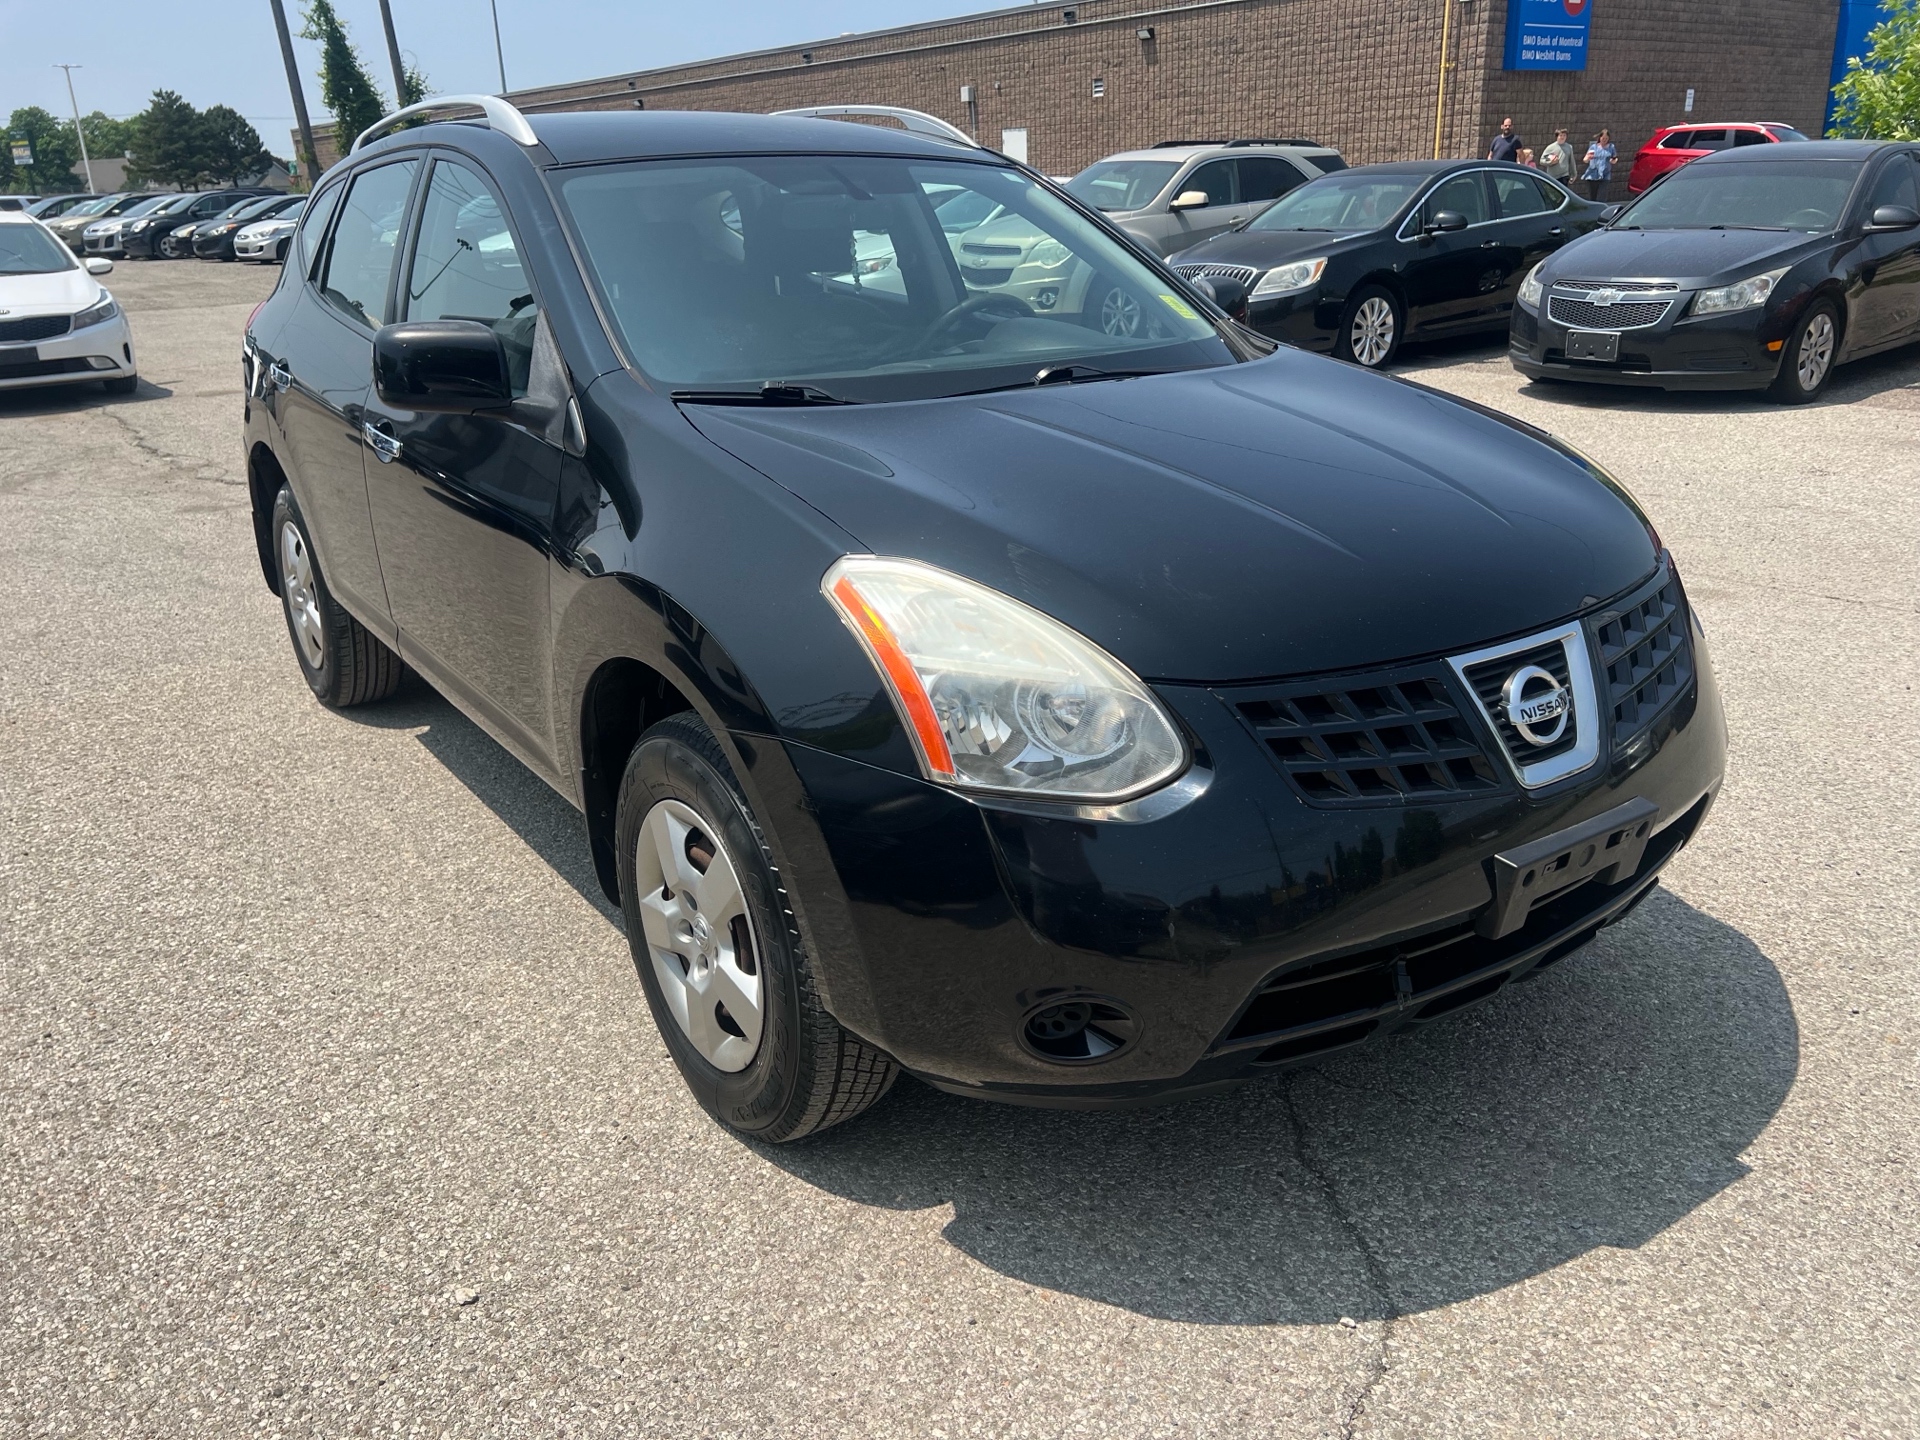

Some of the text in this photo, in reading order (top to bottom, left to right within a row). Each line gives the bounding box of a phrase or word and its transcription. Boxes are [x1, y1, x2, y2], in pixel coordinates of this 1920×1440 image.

[1523, 35, 1583, 47] BMO Bank of Montreal
[1522, 50, 1571, 61] BMO Nesbitt Burns
[1520, 696, 1567, 720] NISSAN
[731, 872, 790, 1123] OPEN COUNTRY
